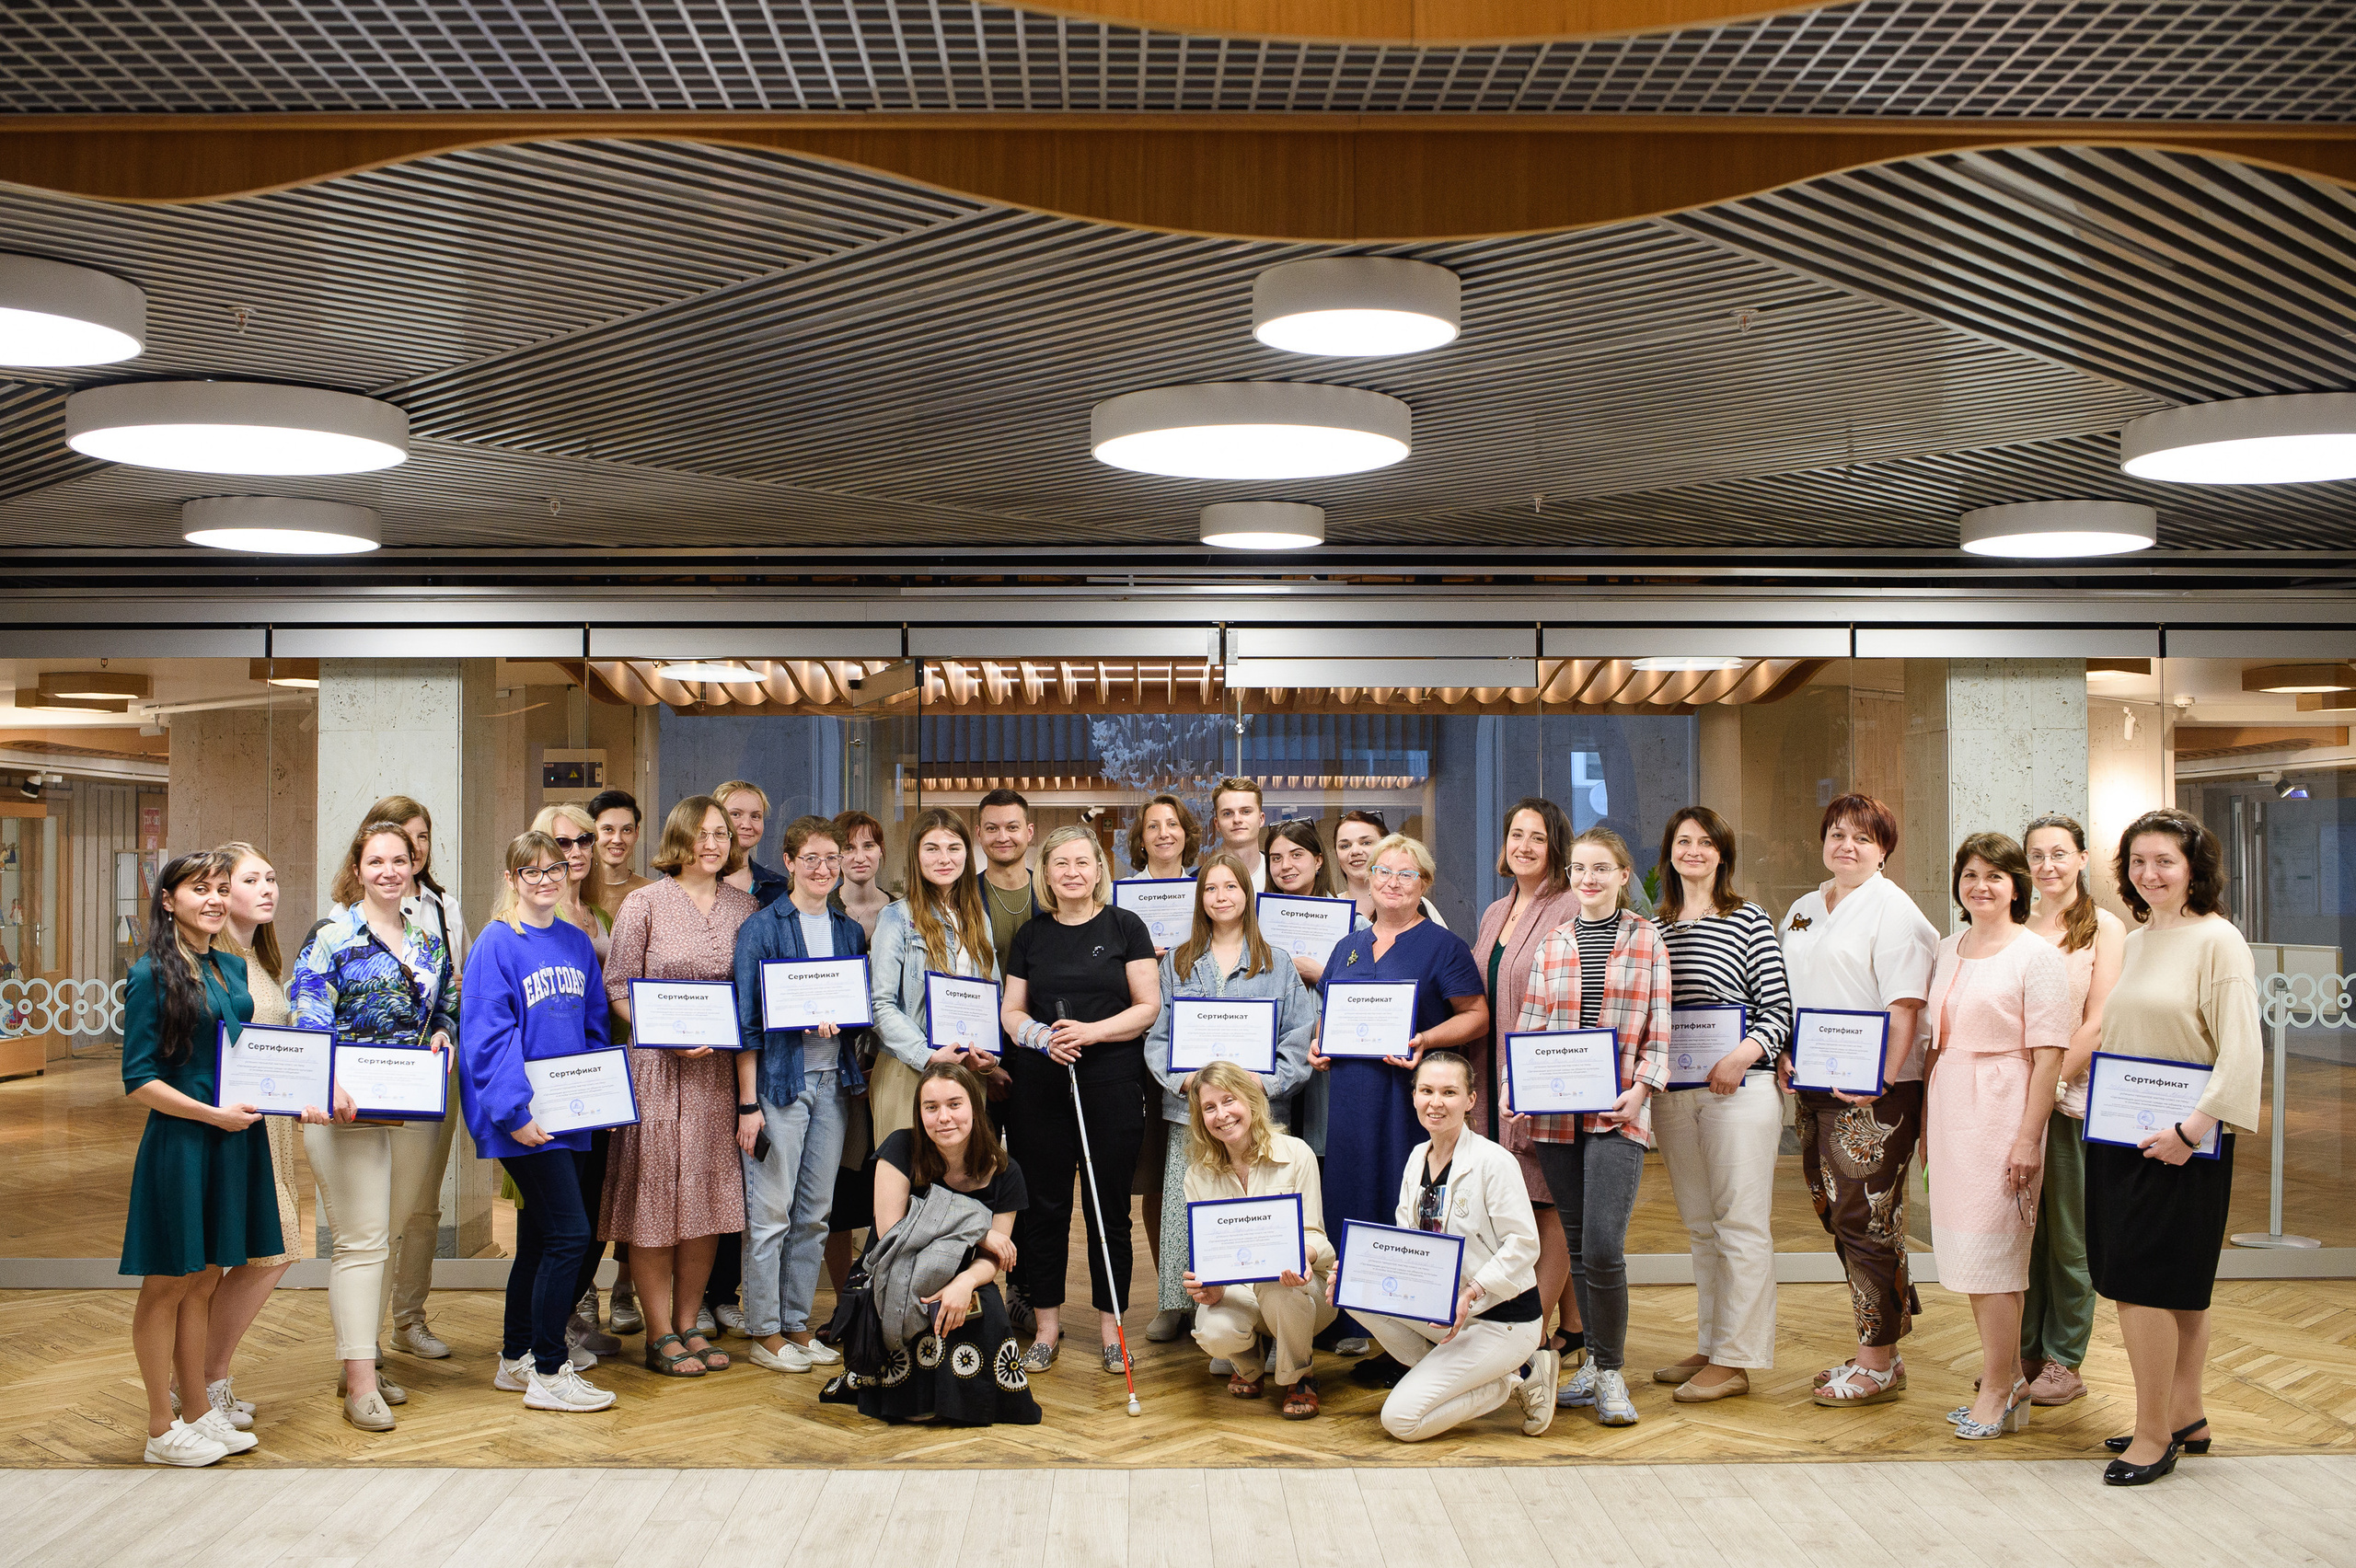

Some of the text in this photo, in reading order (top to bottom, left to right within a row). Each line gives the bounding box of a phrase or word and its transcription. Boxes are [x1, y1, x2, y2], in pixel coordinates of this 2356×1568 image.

[1138, 894, 1186, 902] Сертификат
[1280, 909, 1329, 919] Сертификат
[788, 972, 840, 981] Сертификат
[522, 965, 586, 1009] EAST COAS
[657, 993, 710, 1002] Сертификат
[945, 989, 981, 999] Сертификат
[1347, 996, 1392, 1004] Сертификат
[1196, 1012, 1249, 1020] Сертификат
[1671, 1022, 1716, 1031] ертификат
[1819, 1025, 1863, 1035] Сертификат
[248, 1043, 305, 1054] Сертификат
[1534, 1046, 1588, 1056] Сертификат
[357, 1057, 416, 1066] Сертификат
[549, 1066, 602, 1078] Сертификат
[2123, 1074, 2189, 1089] Сертификат
[1217, 1214, 1272, 1225] Сертификат
[1372, 1241, 1430, 1257] Сертификат
[1528, 1384, 1545, 1407] N
